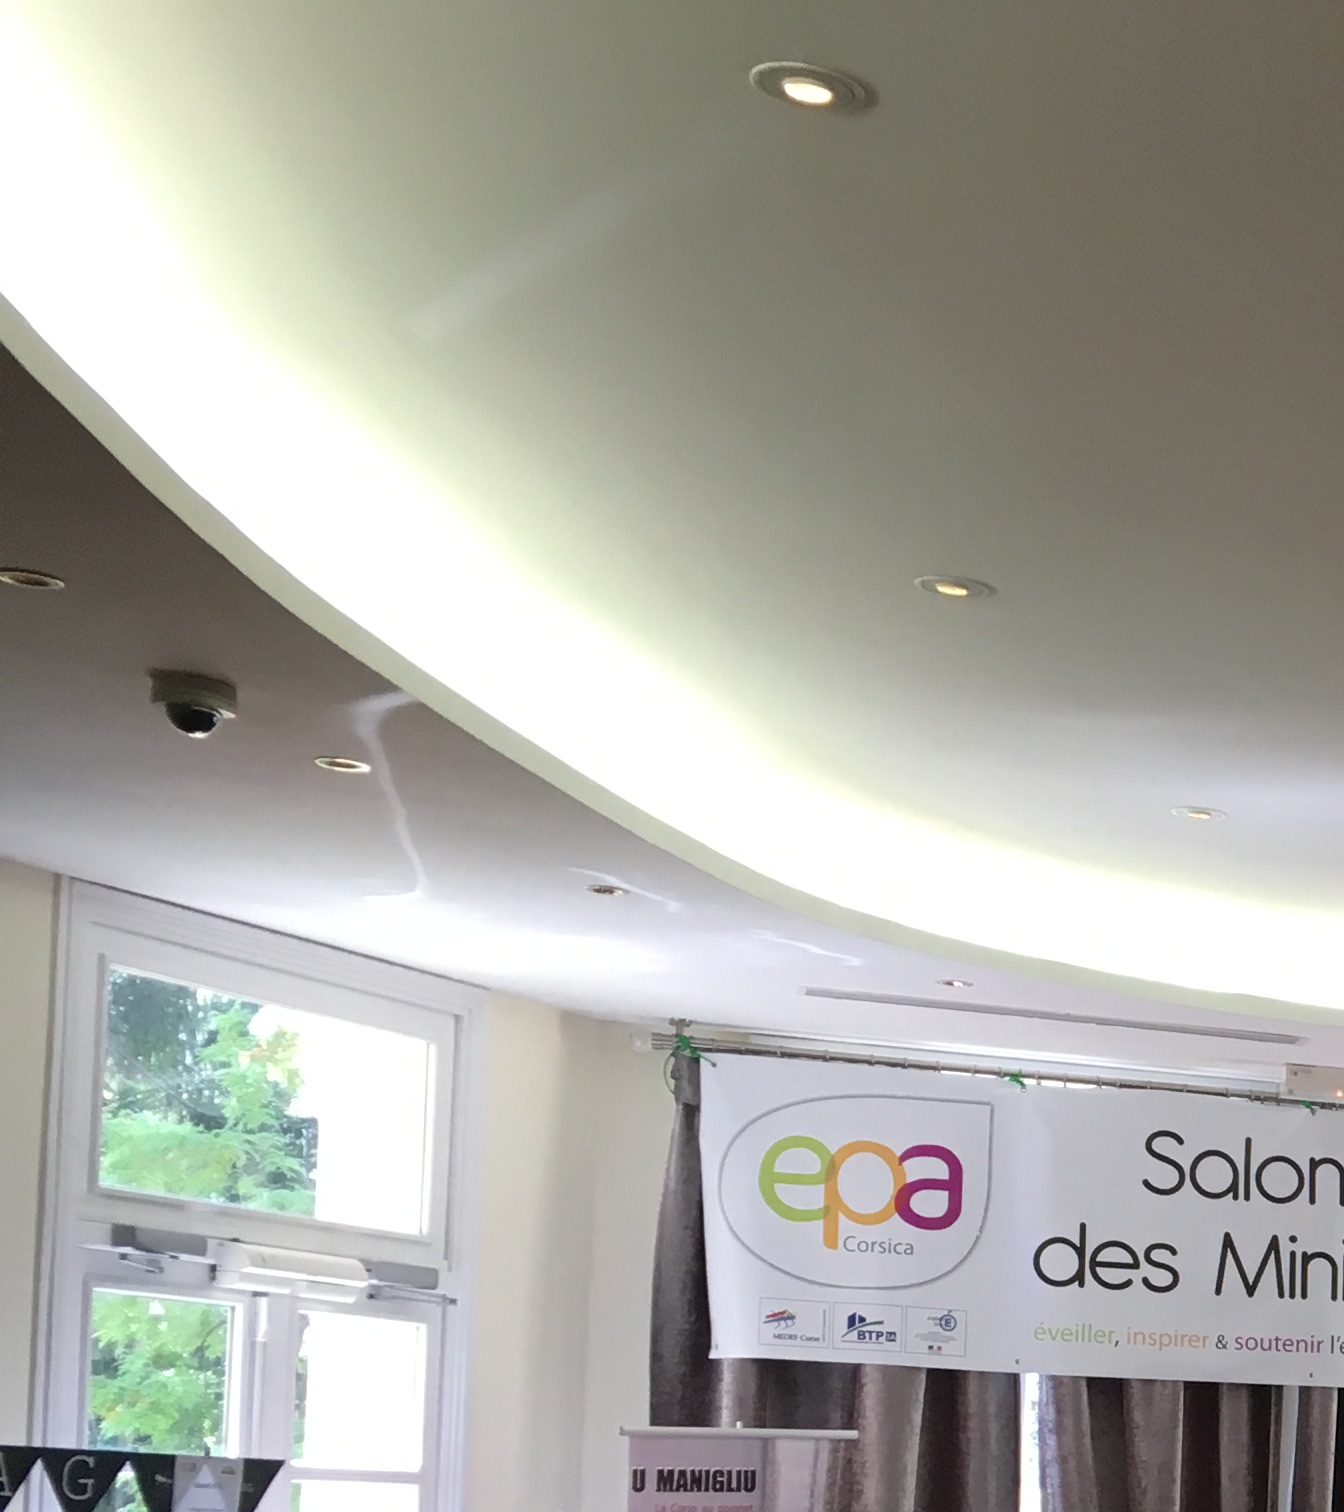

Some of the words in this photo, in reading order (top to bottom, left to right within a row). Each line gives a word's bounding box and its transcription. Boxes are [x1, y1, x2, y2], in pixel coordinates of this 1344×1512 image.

[759, 1135, 963, 1250] epa
[842, 1234, 915, 1257] Corsica
[1033, 1222, 1180, 1294] des
[857, 1330, 883, 1341] BTP
[1033, 1322, 1120, 1347] éveiller,
[1126, 1327, 1209, 1351] inspirer
[1215, 1334, 1228, 1350] &
[1234, 1335, 1324, 1354] soutenir
[632, 1468, 646, 1492] U
[655, 1468, 757, 1493] MANIGLIU
[701, 1505, 714, 1512] au
